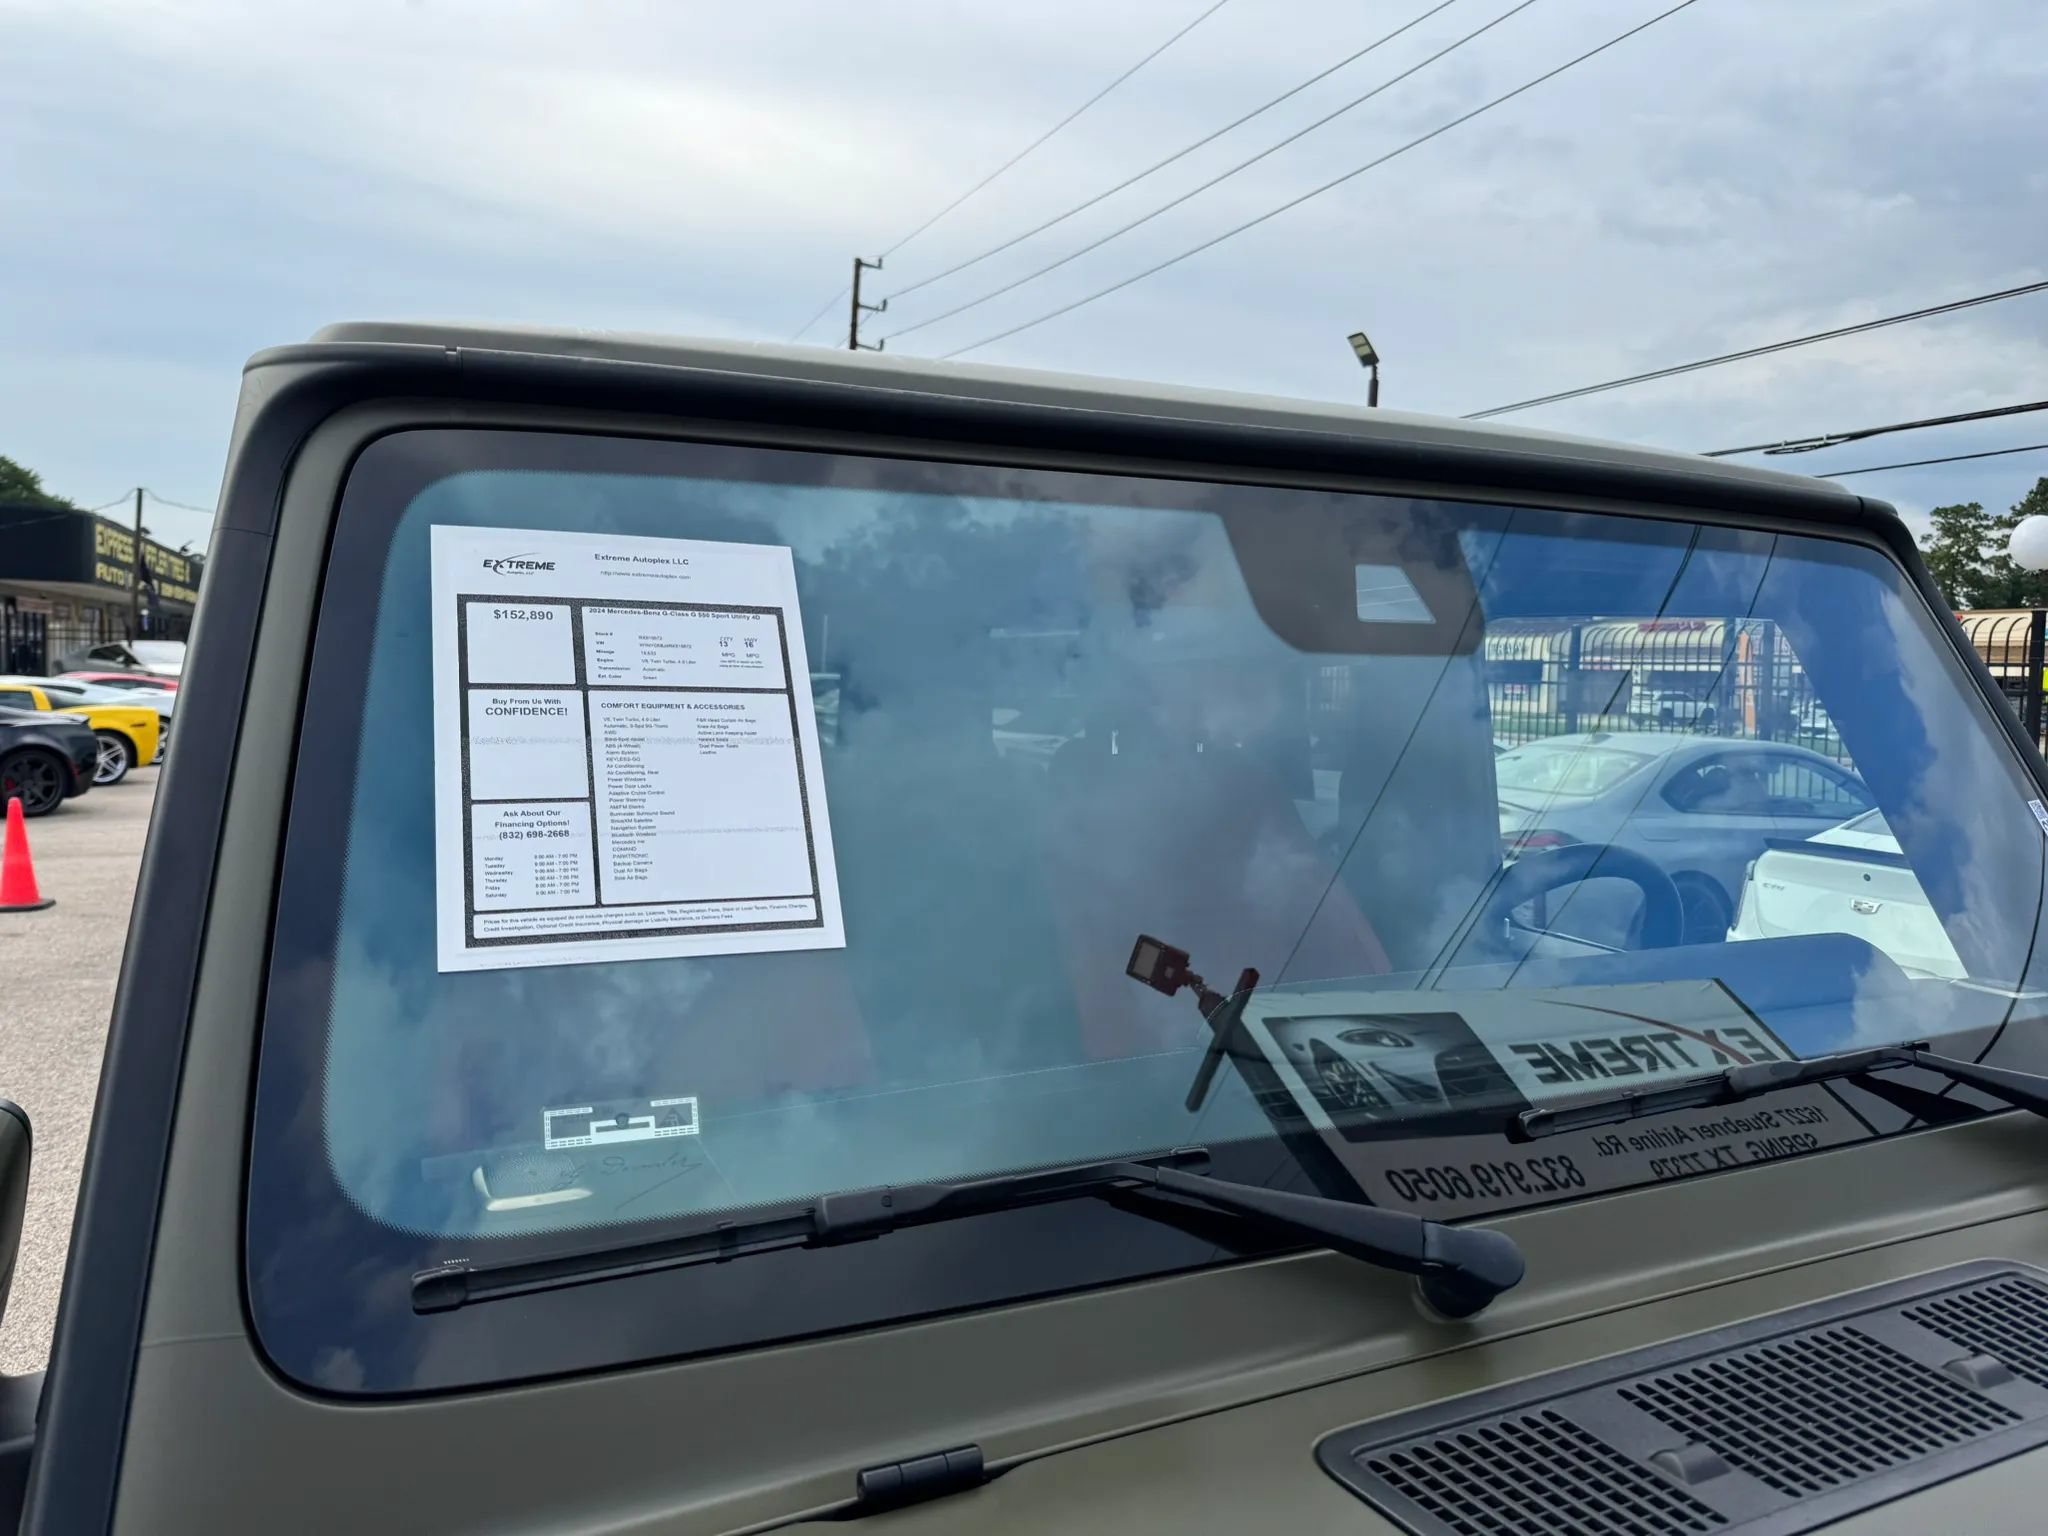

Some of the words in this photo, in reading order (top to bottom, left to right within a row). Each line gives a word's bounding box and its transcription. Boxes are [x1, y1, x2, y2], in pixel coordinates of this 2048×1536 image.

[482, 558, 556, 572] EXTREME
[594, 553, 631, 562] Extreme
[632, 556, 670, 566] Autoplex
[493, 608, 554, 620] $152,890
[485, 707, 568, 716] CONFIDENCE!
[499, 832, 524, 840] (832)
[526, 830, 570, 838] 698-2668
